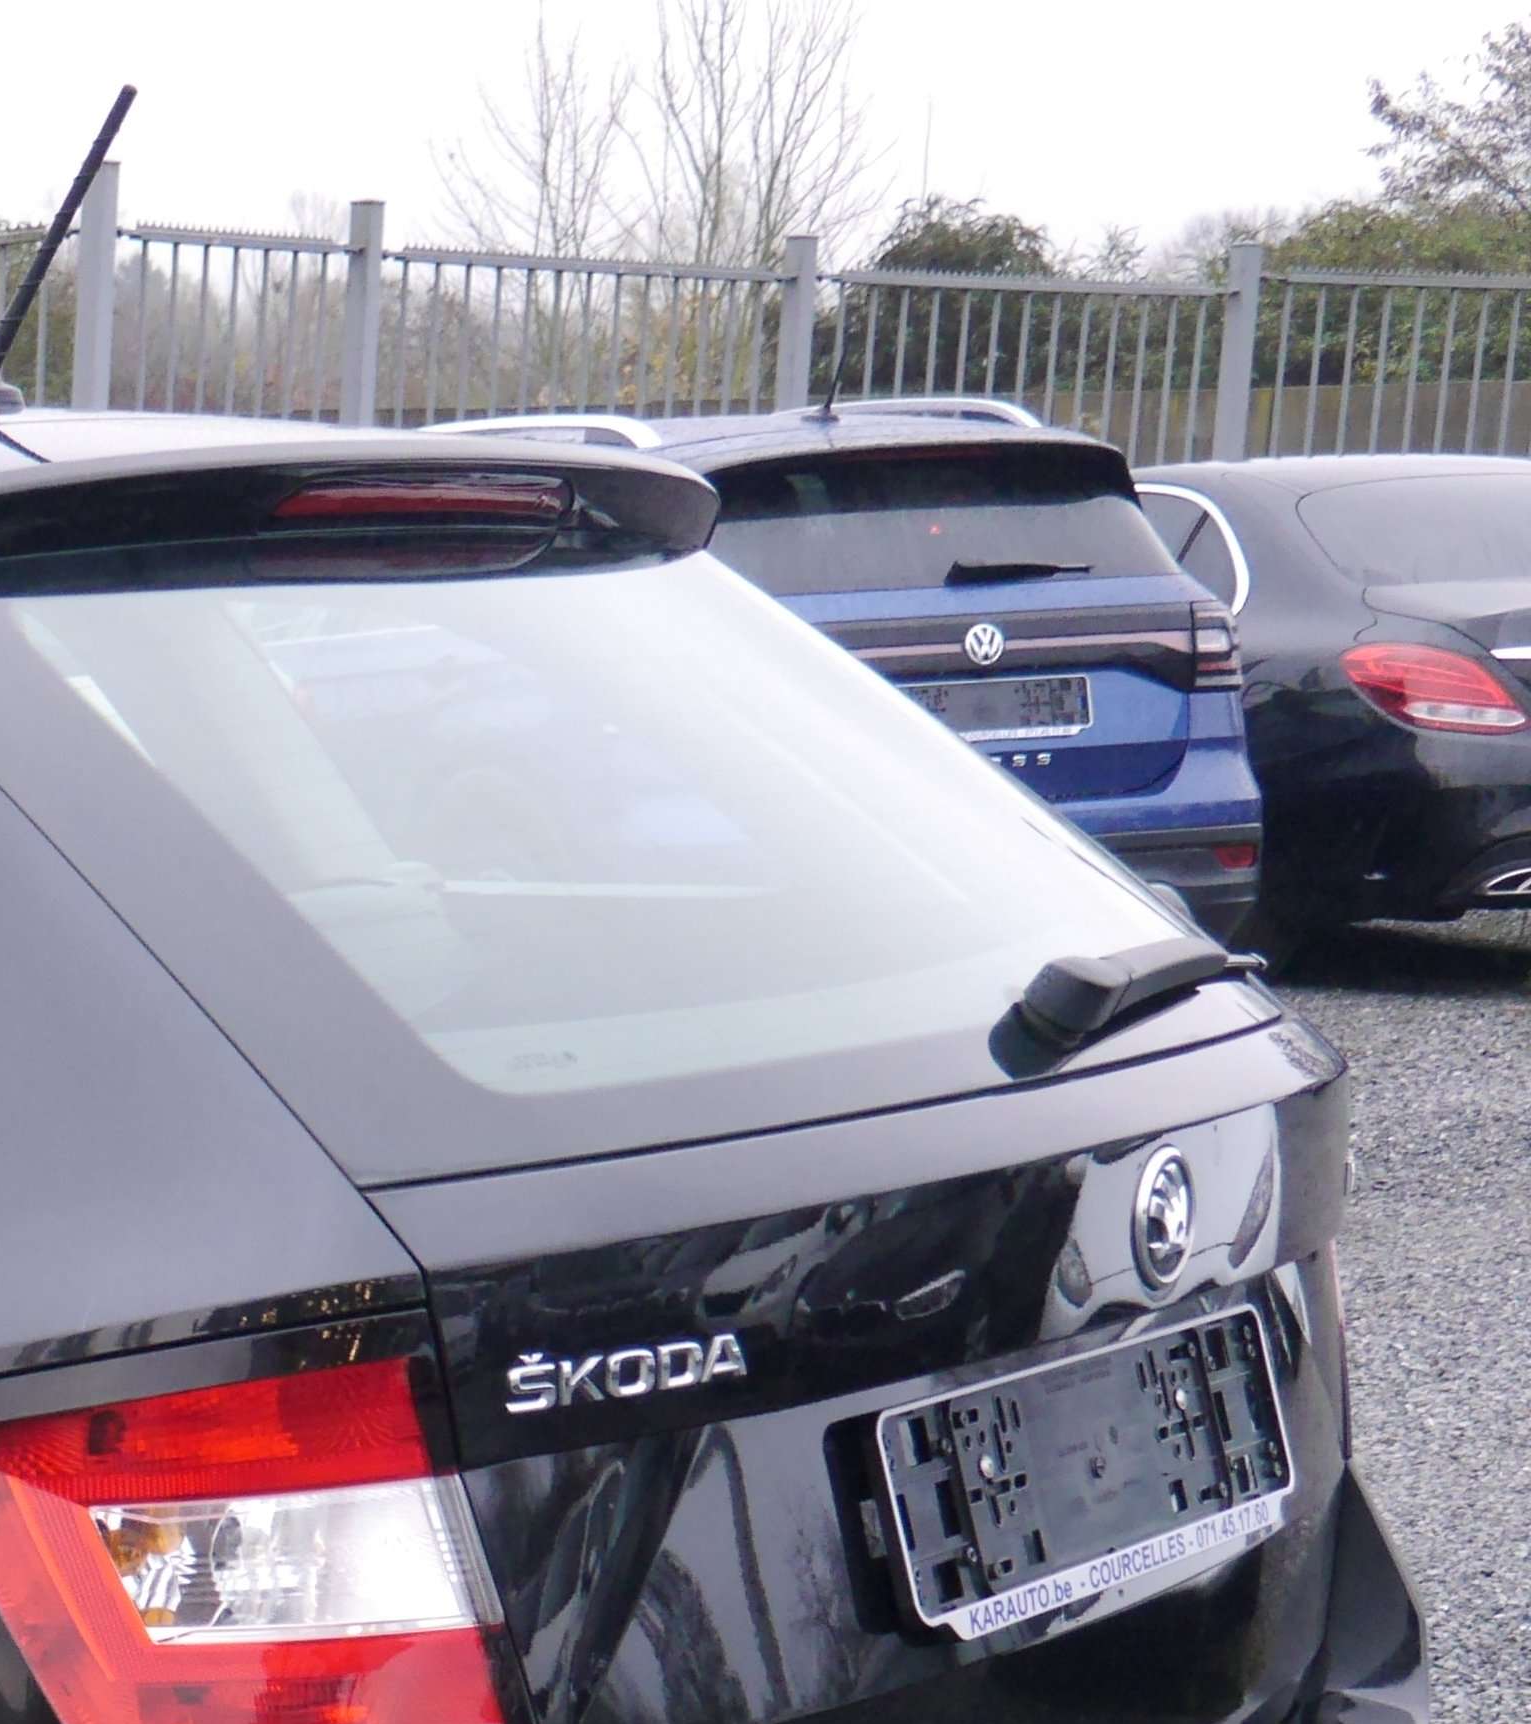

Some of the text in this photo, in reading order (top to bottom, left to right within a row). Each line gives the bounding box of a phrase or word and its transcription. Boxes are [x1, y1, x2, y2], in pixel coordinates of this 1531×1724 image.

[504, 1333, 748, 1415] ŠKODA
[968, 1580, 1073, 1635] KARAUTO.be
[1088, 1532, 1187, 1588] COURCELLES
